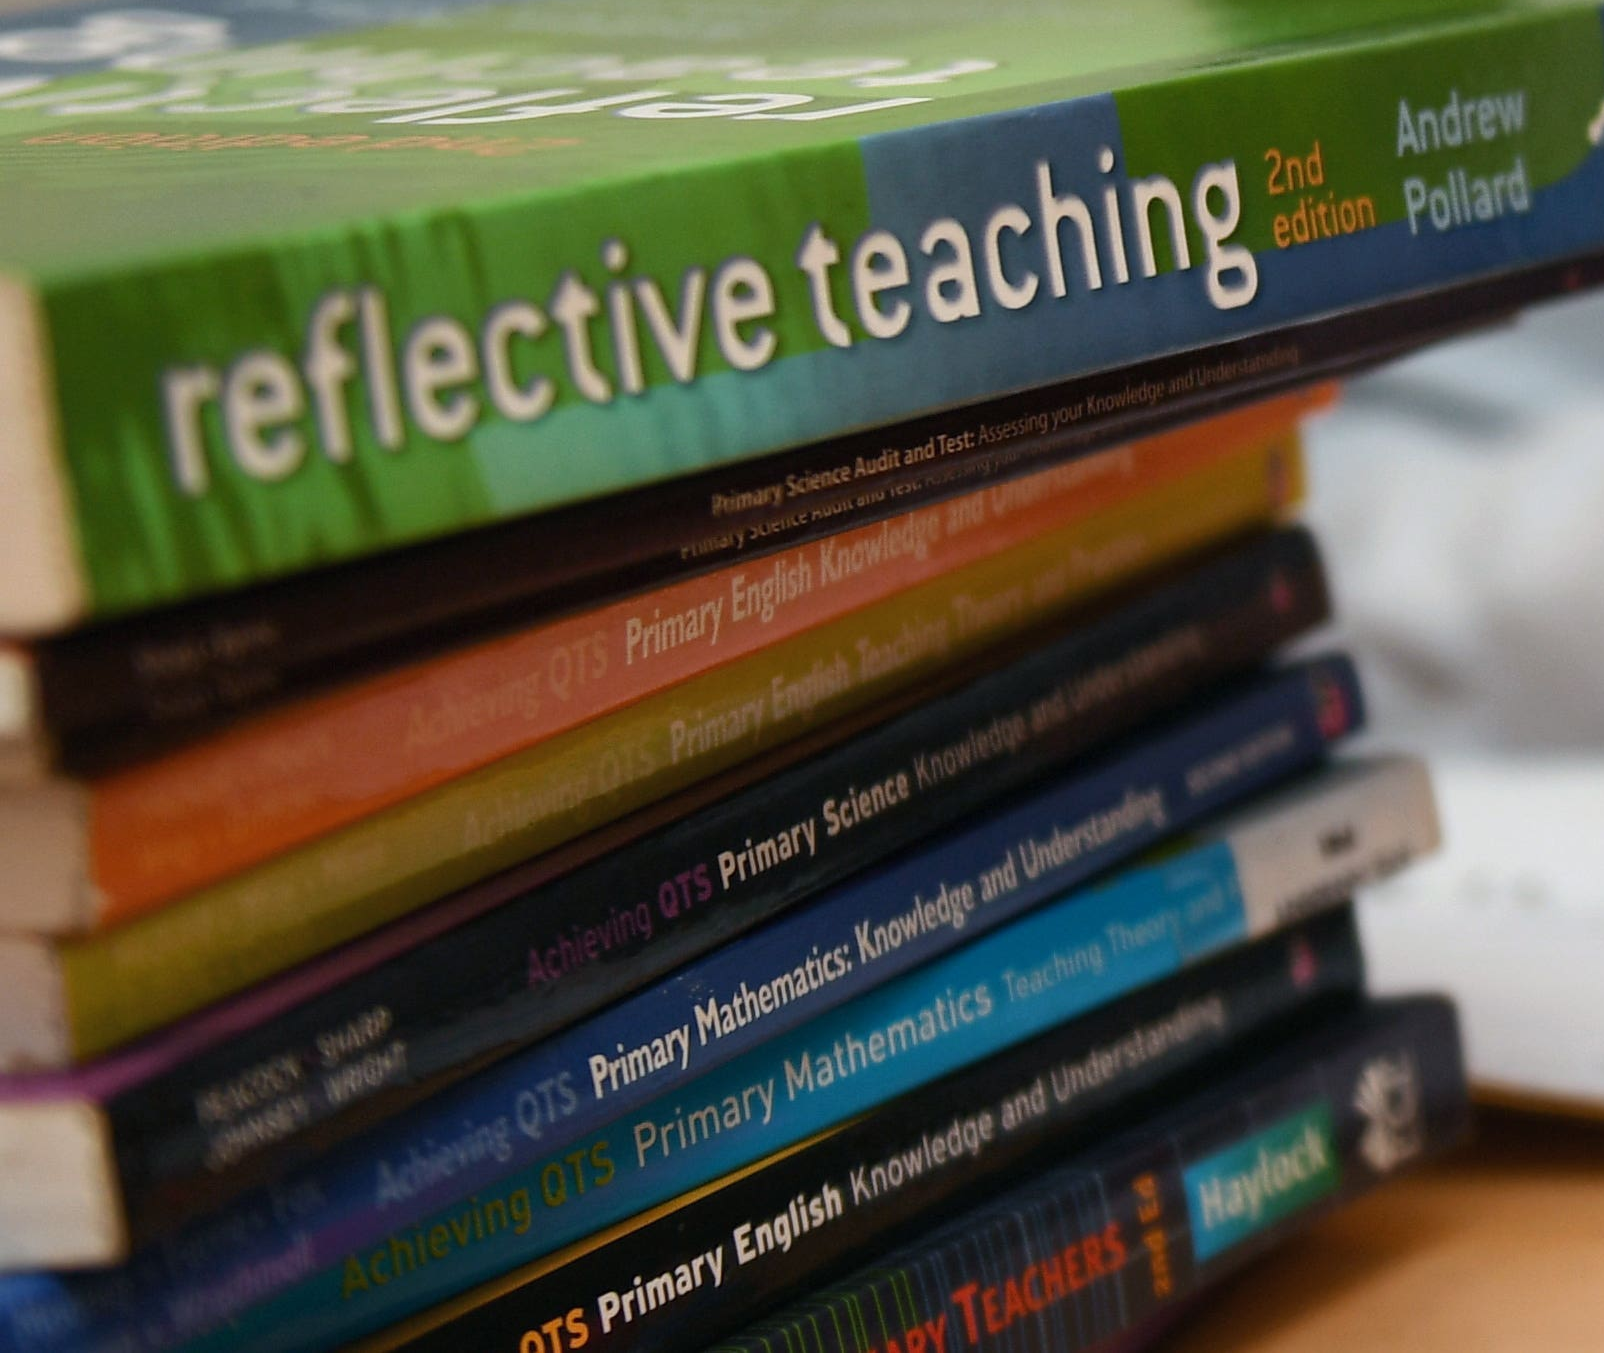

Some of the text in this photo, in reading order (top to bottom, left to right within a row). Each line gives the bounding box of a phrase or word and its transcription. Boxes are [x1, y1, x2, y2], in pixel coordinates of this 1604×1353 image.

[1263, 141, 1325, 195] 2nd
[1396, 89, 1527, 157] Andrew
[1272, 195, 1377, 248] edition
[1403, 158, 1532, 235] Pollard
[162, 148, 1259, 496] reflective teaching
[710, 484, 784, 518] Primary
[786, 464, 850, 495] Science
[854, 449, 901, 478] Audit
[903, 439, 936, 466] and
[937, 430, 976, 457] Test:
[977, 411, 1049, 445] Assessing
[1051, 403, 1084, 432] your
[1086, 380, 1165, 414] Knowledge
[1168, 367, 1195, 392] and
[549, 631, 608, 701] QTS
[625, 597, 724, 666] Primary
[731, 552, 814, 623] English
[819, 510, 940, 588] Knowledge
[947, 488, 985, 536] and
[669, 692, 764, 764] Primary
[772, 652, 850, 722] English
[525, 900, 653, 989] Achieving
[658, 861, 712, 920] QTS
[717, 816, 817, 891] Primary
[822, 771, 910, 836] Science
[913, 714, 1026, 790] Knowledge
[374, 788, 1167, 1208] Achieving QTS Primary Mathematics: Knowledge and Understanding
[340, 1182, 533, 1300] Achieving
[540, 1140, 616, 1209] QTS
[633, 1076, 775, 1168] Primary
[784, 978, 993, 1102] Mathematics
[1003, 941, 1105, 1004] Teaching
[597, 1244, 724, 1334] Primary
[733, 1180, 843, 1267] English
[849, 1109, 994, 1207] Knowledge
[1000, 1077, 1047, 1131] and
[1049, 994, 1227, 1105] Understanding
[1200, 1125, 1328, 1230] Haylock
[951, 1219, 1127, 1344] TEACHERS
